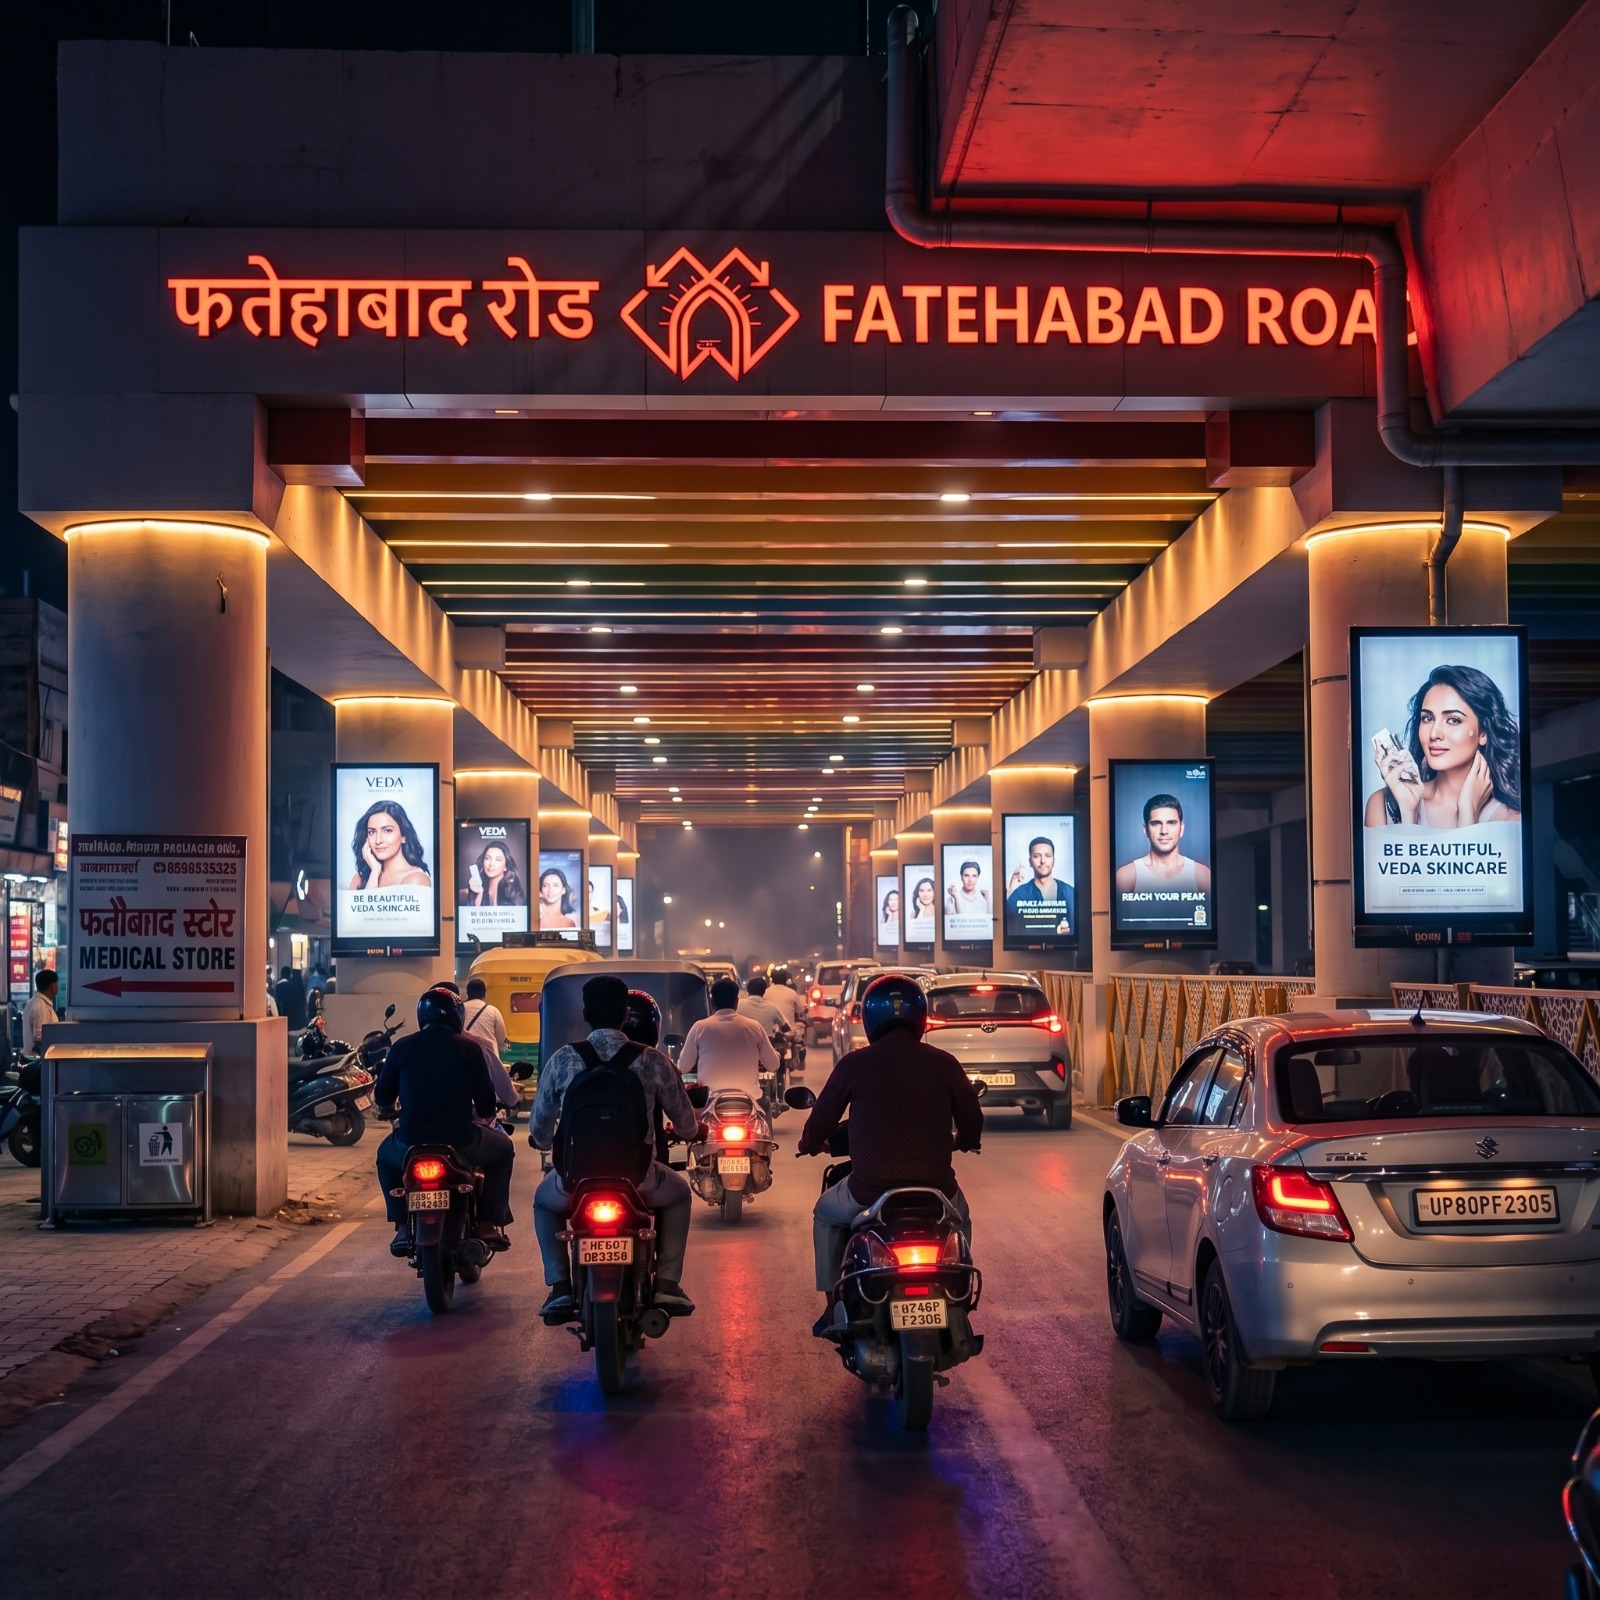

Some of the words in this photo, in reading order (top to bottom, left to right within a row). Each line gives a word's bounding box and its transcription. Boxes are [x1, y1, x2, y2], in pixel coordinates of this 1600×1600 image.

[167, 254, 473, 348] फतेहाबाद
[481, 256, 600, 341] रोड
[823, 284, 1225, 345] FATEHABAD
[1246, 287, 1418, 347] ROA
[365, 776, 404, 788] VEDA
[479, 826, 507, 836] VEDA
[1383, 843, 1404, 857] BE
[1408, 842, 1502, 859] BEAUTIFUL,
[1378, 861, 1422, 875] VEDA
[1426, 861, 1508, 875] SKINCARE
[353, 894, 366, 903] BE
[367, 894, 419, 904] BEAUTIFUL,
[1121, 892, 1153, 902] REACH
[1154, 892, 1180, 901] YOUR
[1181, 892, 1206, 901] PEAK
[350, 904, 375, 913] VEDA
[377, 904, 421, 913] SKINCARE
[79, 946, 167, 970] MEDICAL
[172, 946, 235, 971] STORE
[1429, 1193, 1552, 1216] UP80PF2305
